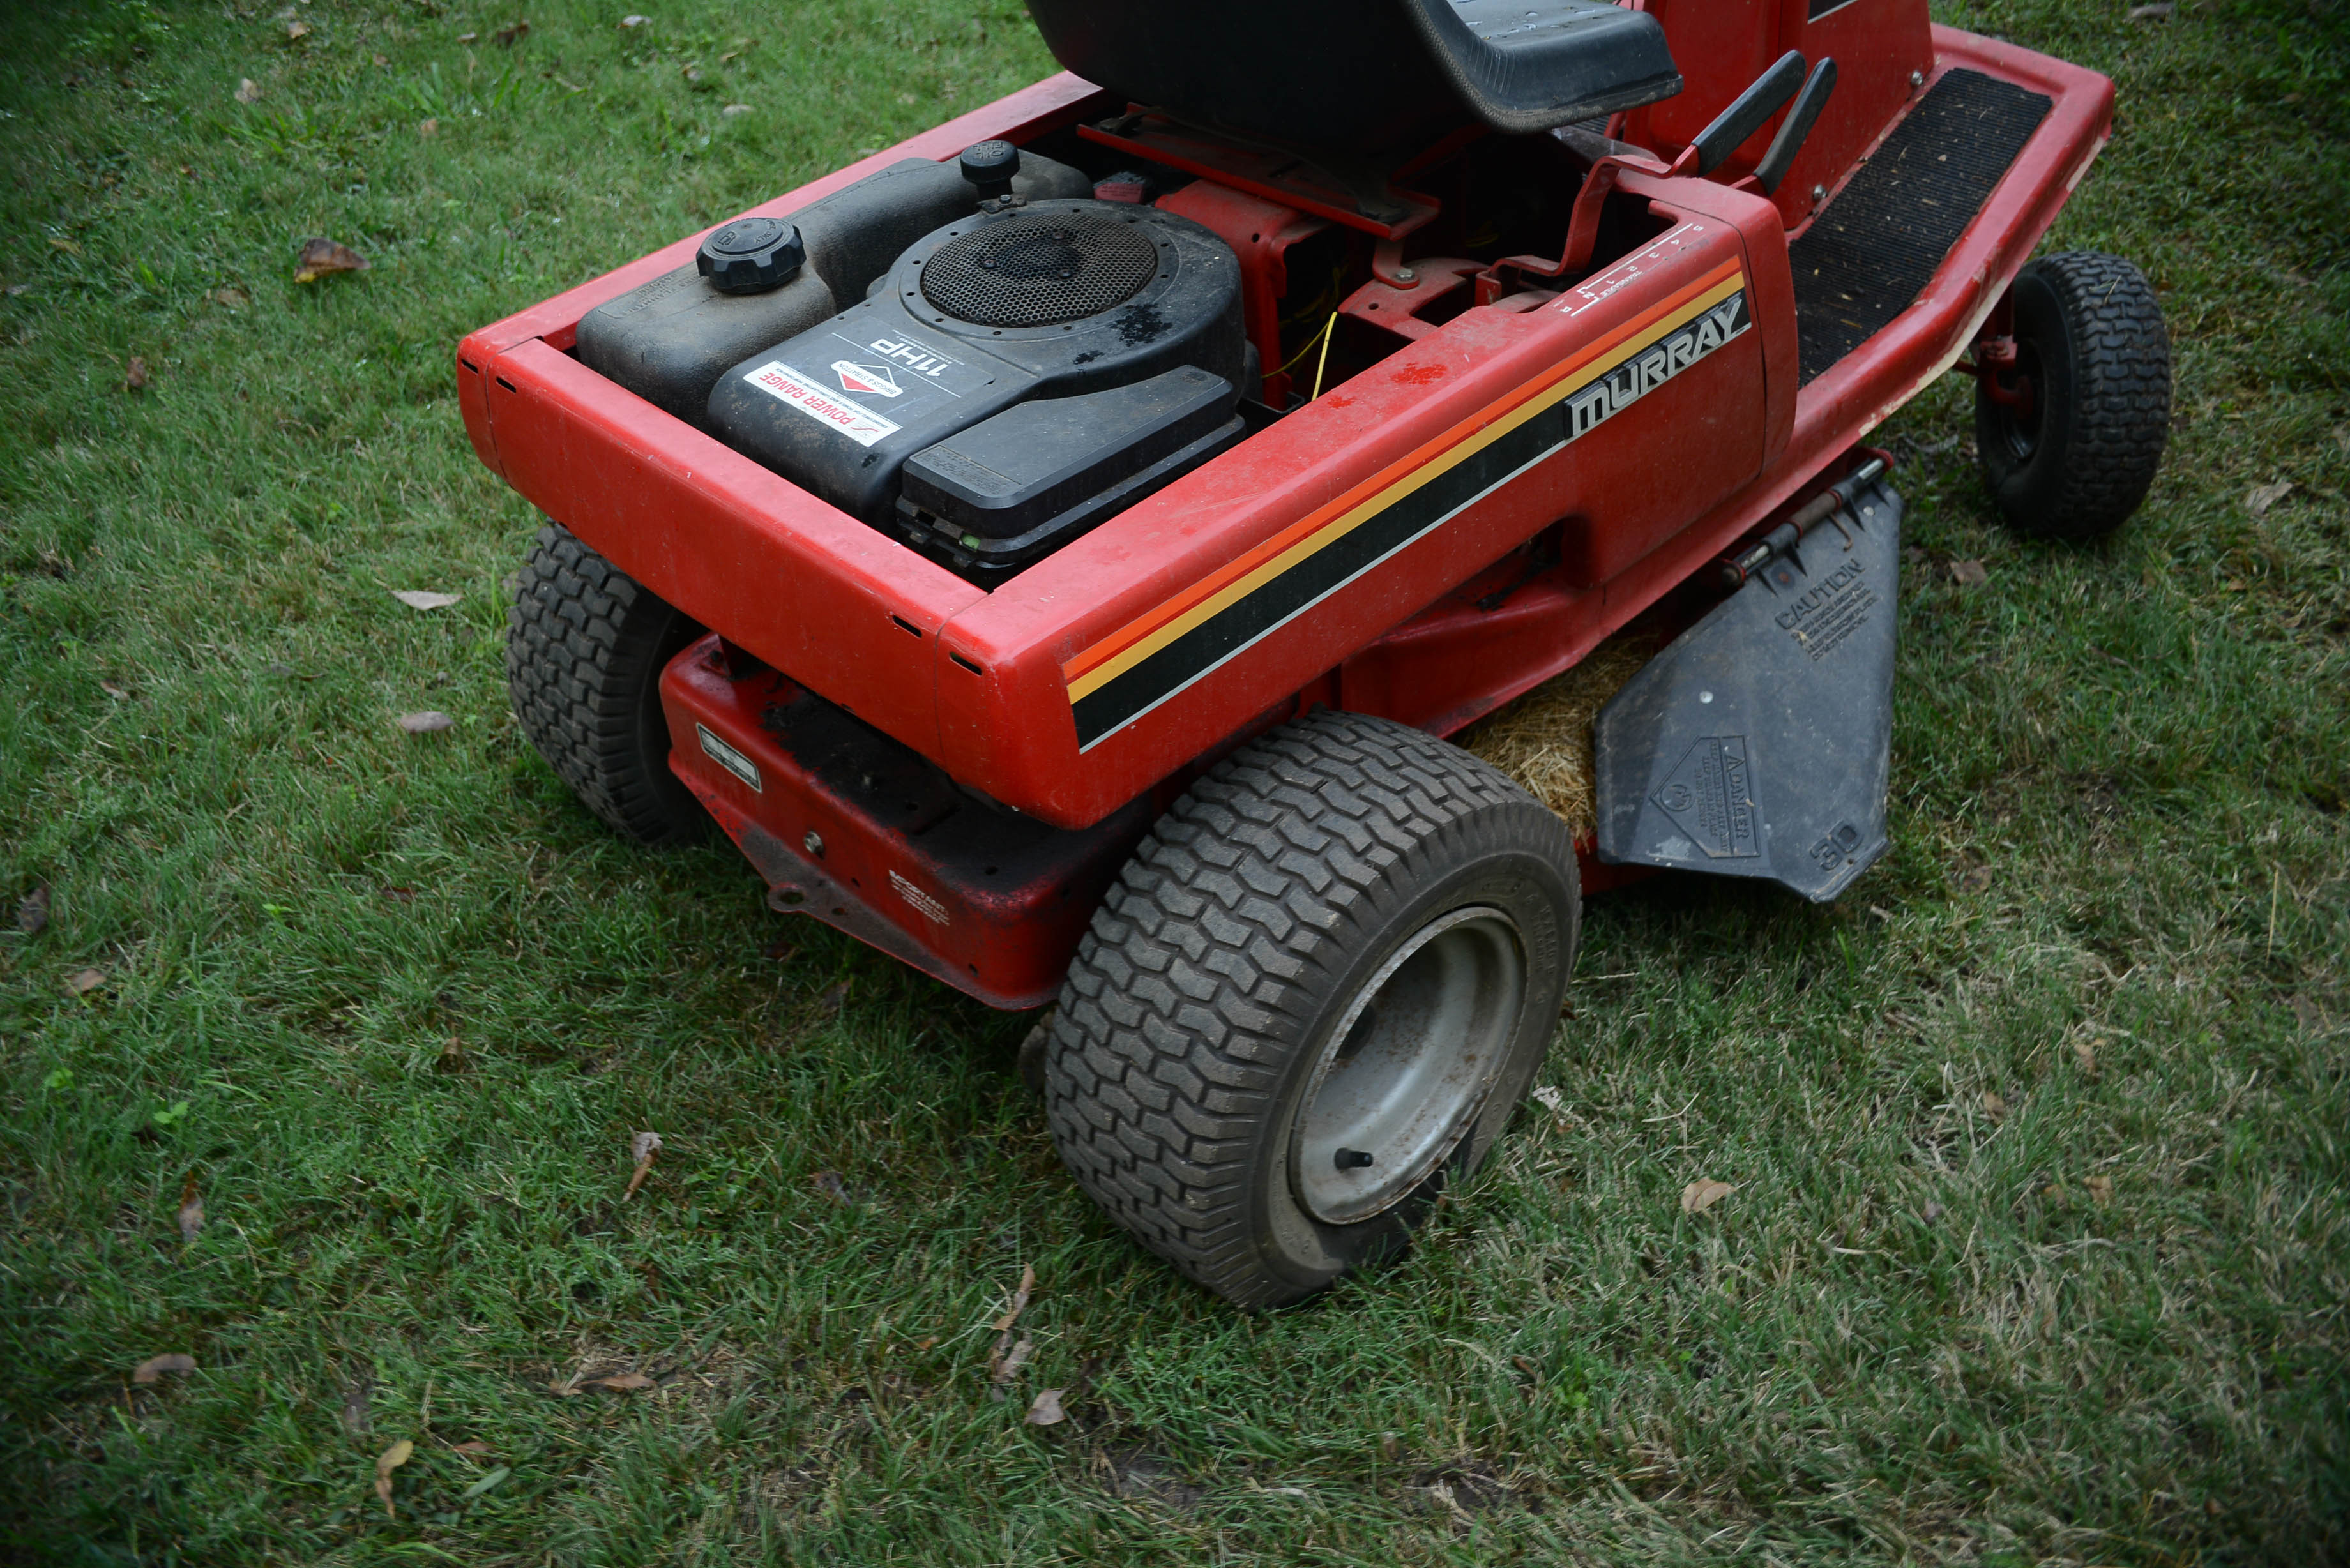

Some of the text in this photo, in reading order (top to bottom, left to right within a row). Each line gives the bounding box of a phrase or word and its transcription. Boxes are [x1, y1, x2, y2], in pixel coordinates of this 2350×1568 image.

[755, 230, 772, 244] ONLY
[1648, 249, 1660, 260] 3
[1625, 262, 1639, 274] 2
[1605, 276, 1616, 287] 1
[1581, 289, 1595, 301] N
[1558, 303, 1572, 315] R
[868, 337, 948, 378] 11HP
[837, 362, 868, 380] STRATTON
[1566, 295, 1743, 439] MURRAY
[871, 380, 896, 395] BRIGGS
[758, 370, 856, 425] POWER RANGE
[1773, 557, 1865, 630] CAUTION
[1729, 771, 1750, 840] DANGER
